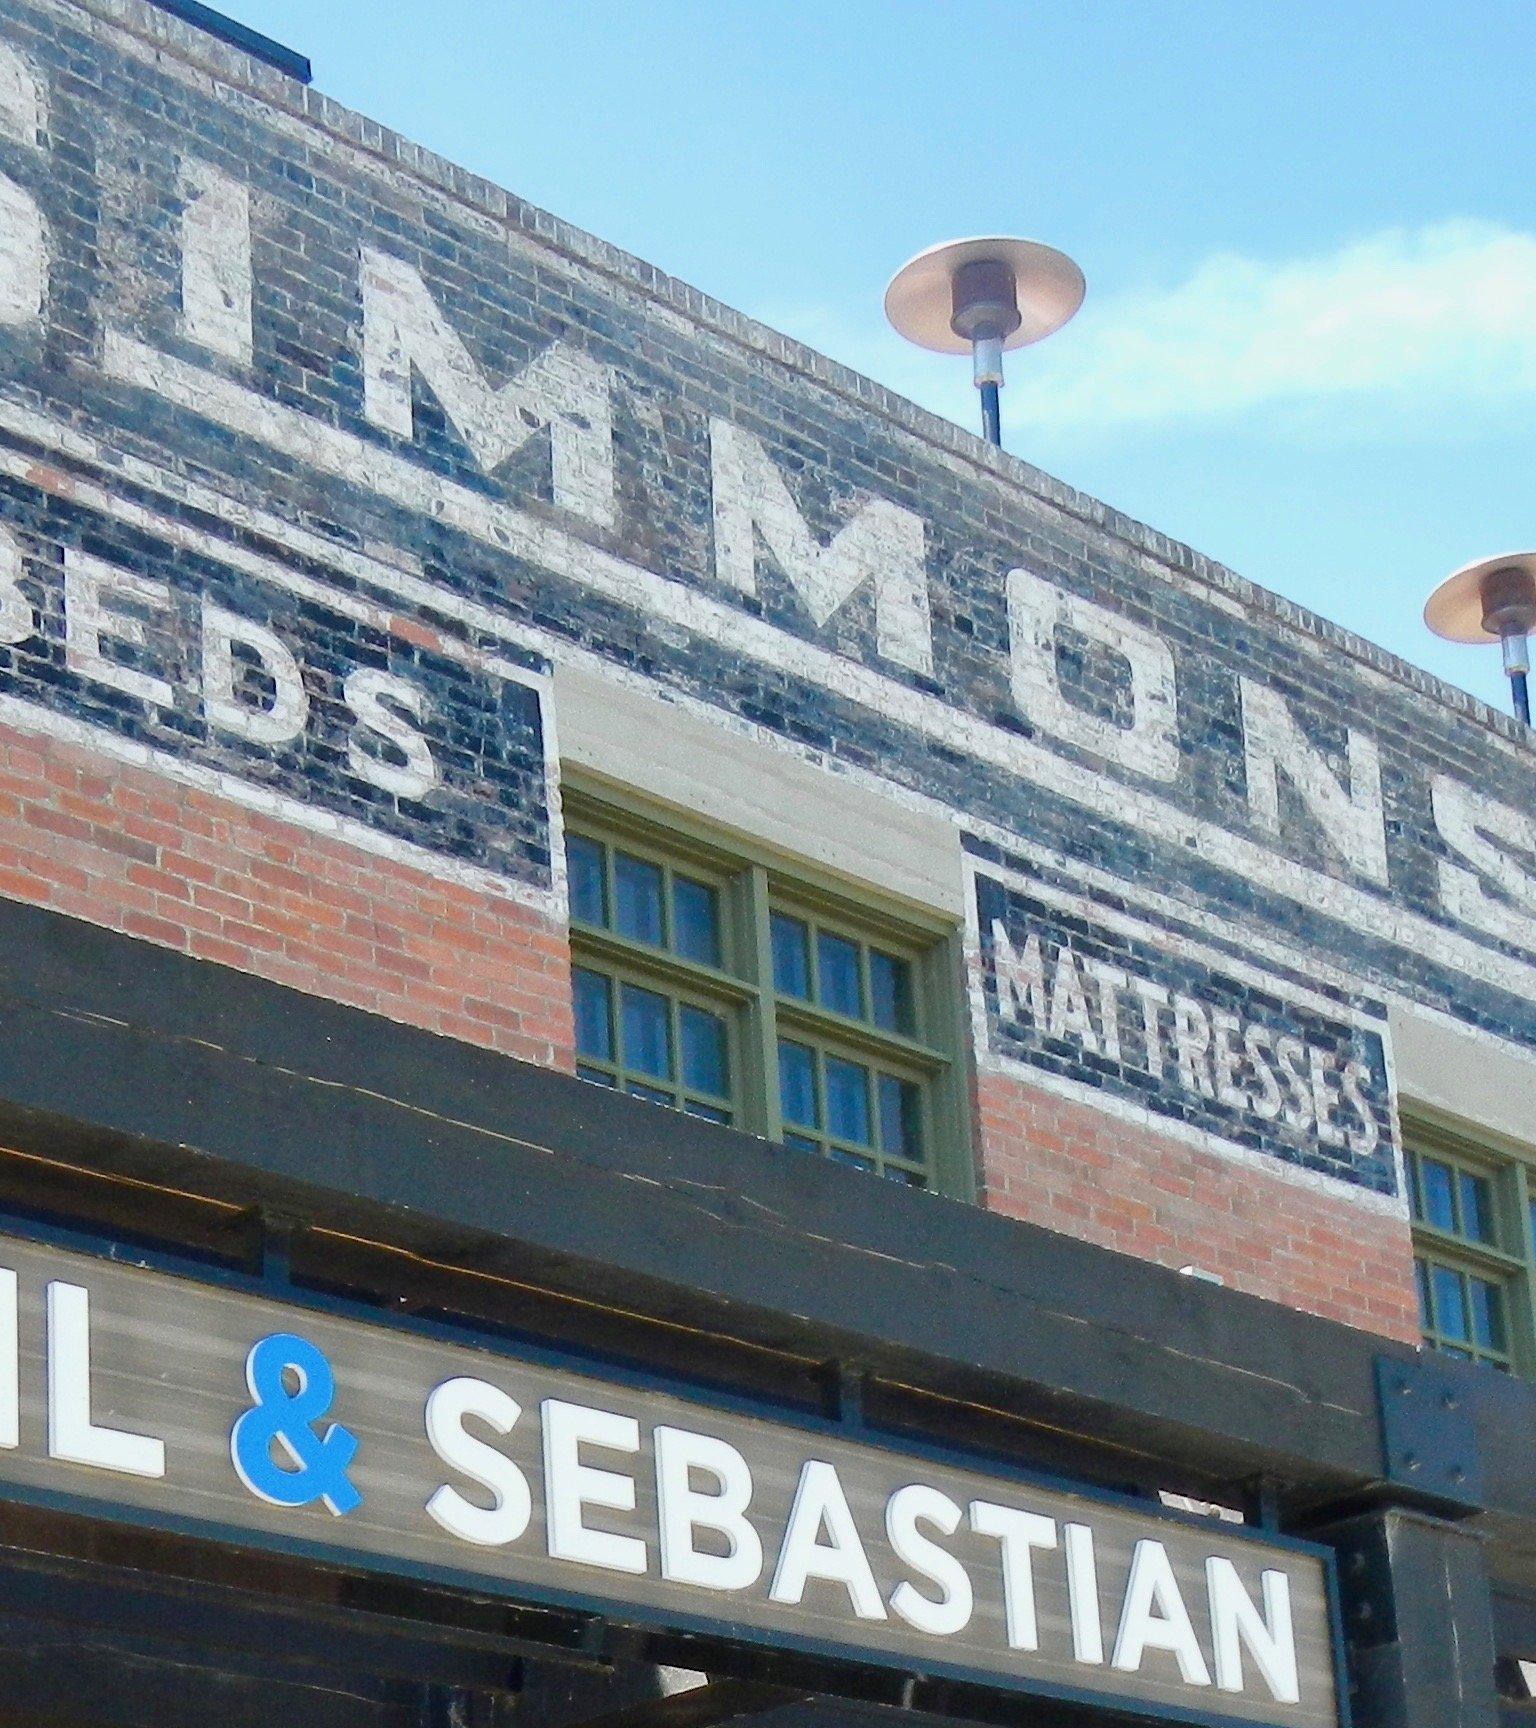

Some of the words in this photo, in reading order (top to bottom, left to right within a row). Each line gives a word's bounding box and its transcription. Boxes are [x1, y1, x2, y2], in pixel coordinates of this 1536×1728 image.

[990, 915, 1380, 1158] MATTRESSES
[230, 1332, 365, 1518] &
[423, 1375, 1300, 1704] SEBASTIAN
